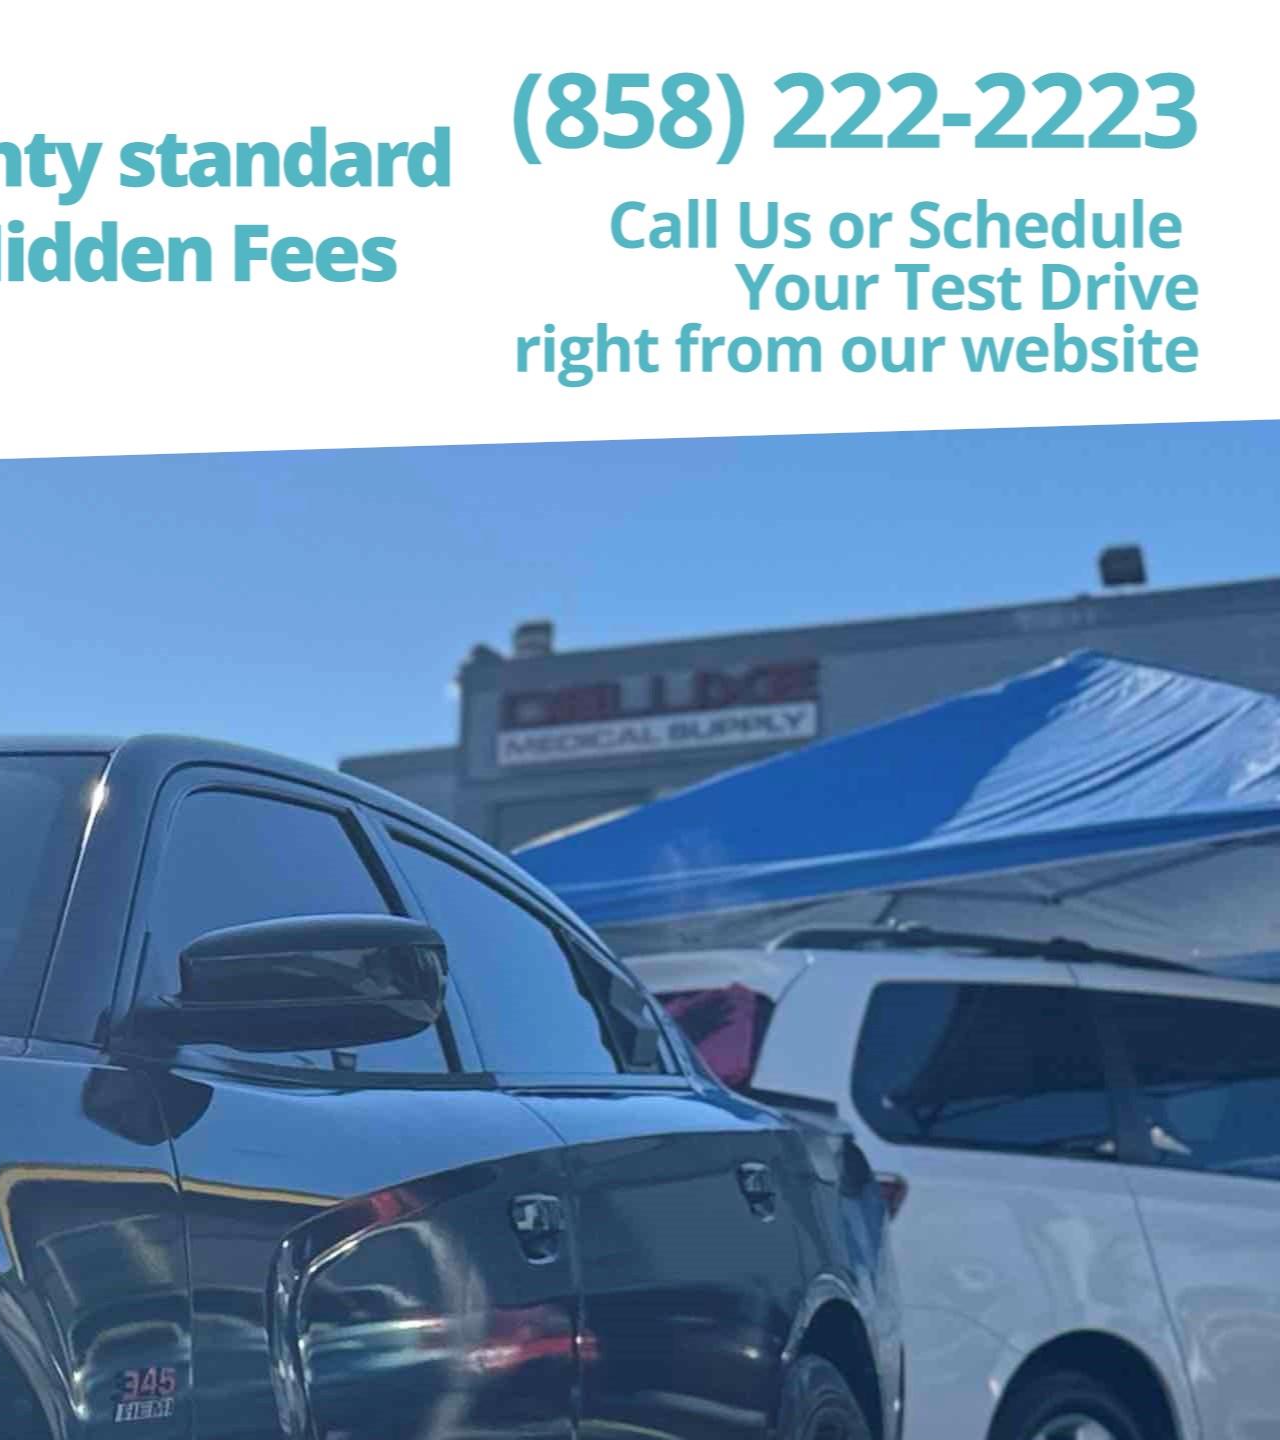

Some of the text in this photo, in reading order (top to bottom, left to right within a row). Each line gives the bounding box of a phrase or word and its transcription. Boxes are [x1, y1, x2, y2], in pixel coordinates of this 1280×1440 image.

[505, 710, 807, 757] MEDICAL SUPPLY
[123, 1365, 177, 1400] 345
